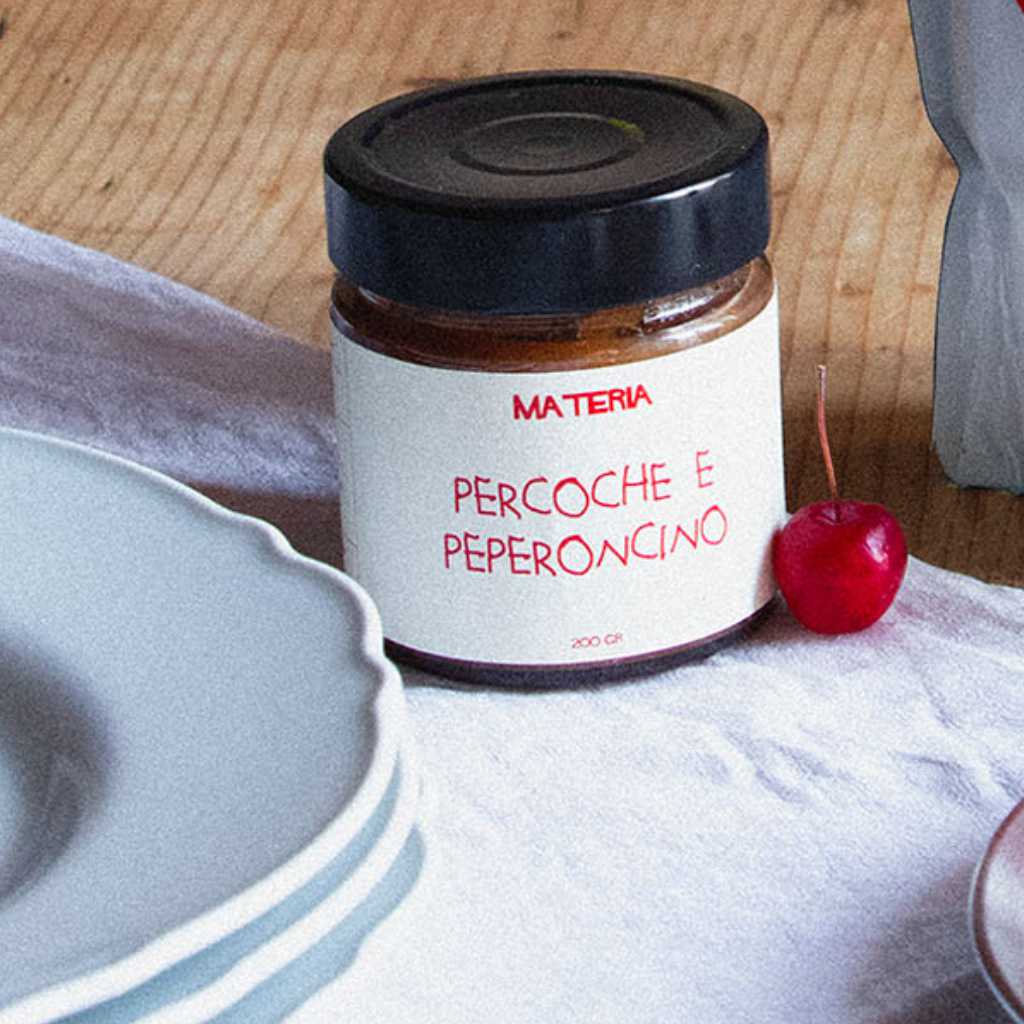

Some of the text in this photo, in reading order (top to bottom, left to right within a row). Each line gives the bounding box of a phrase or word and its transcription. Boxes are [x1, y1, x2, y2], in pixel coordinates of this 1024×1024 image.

[513, 384, 653, 420] MATERIA
[454, 449, 714, 519] PERCOCHE E
[444, 504, 728, 576] PEPERONCINO
[571, 635, 600, 649] 200
